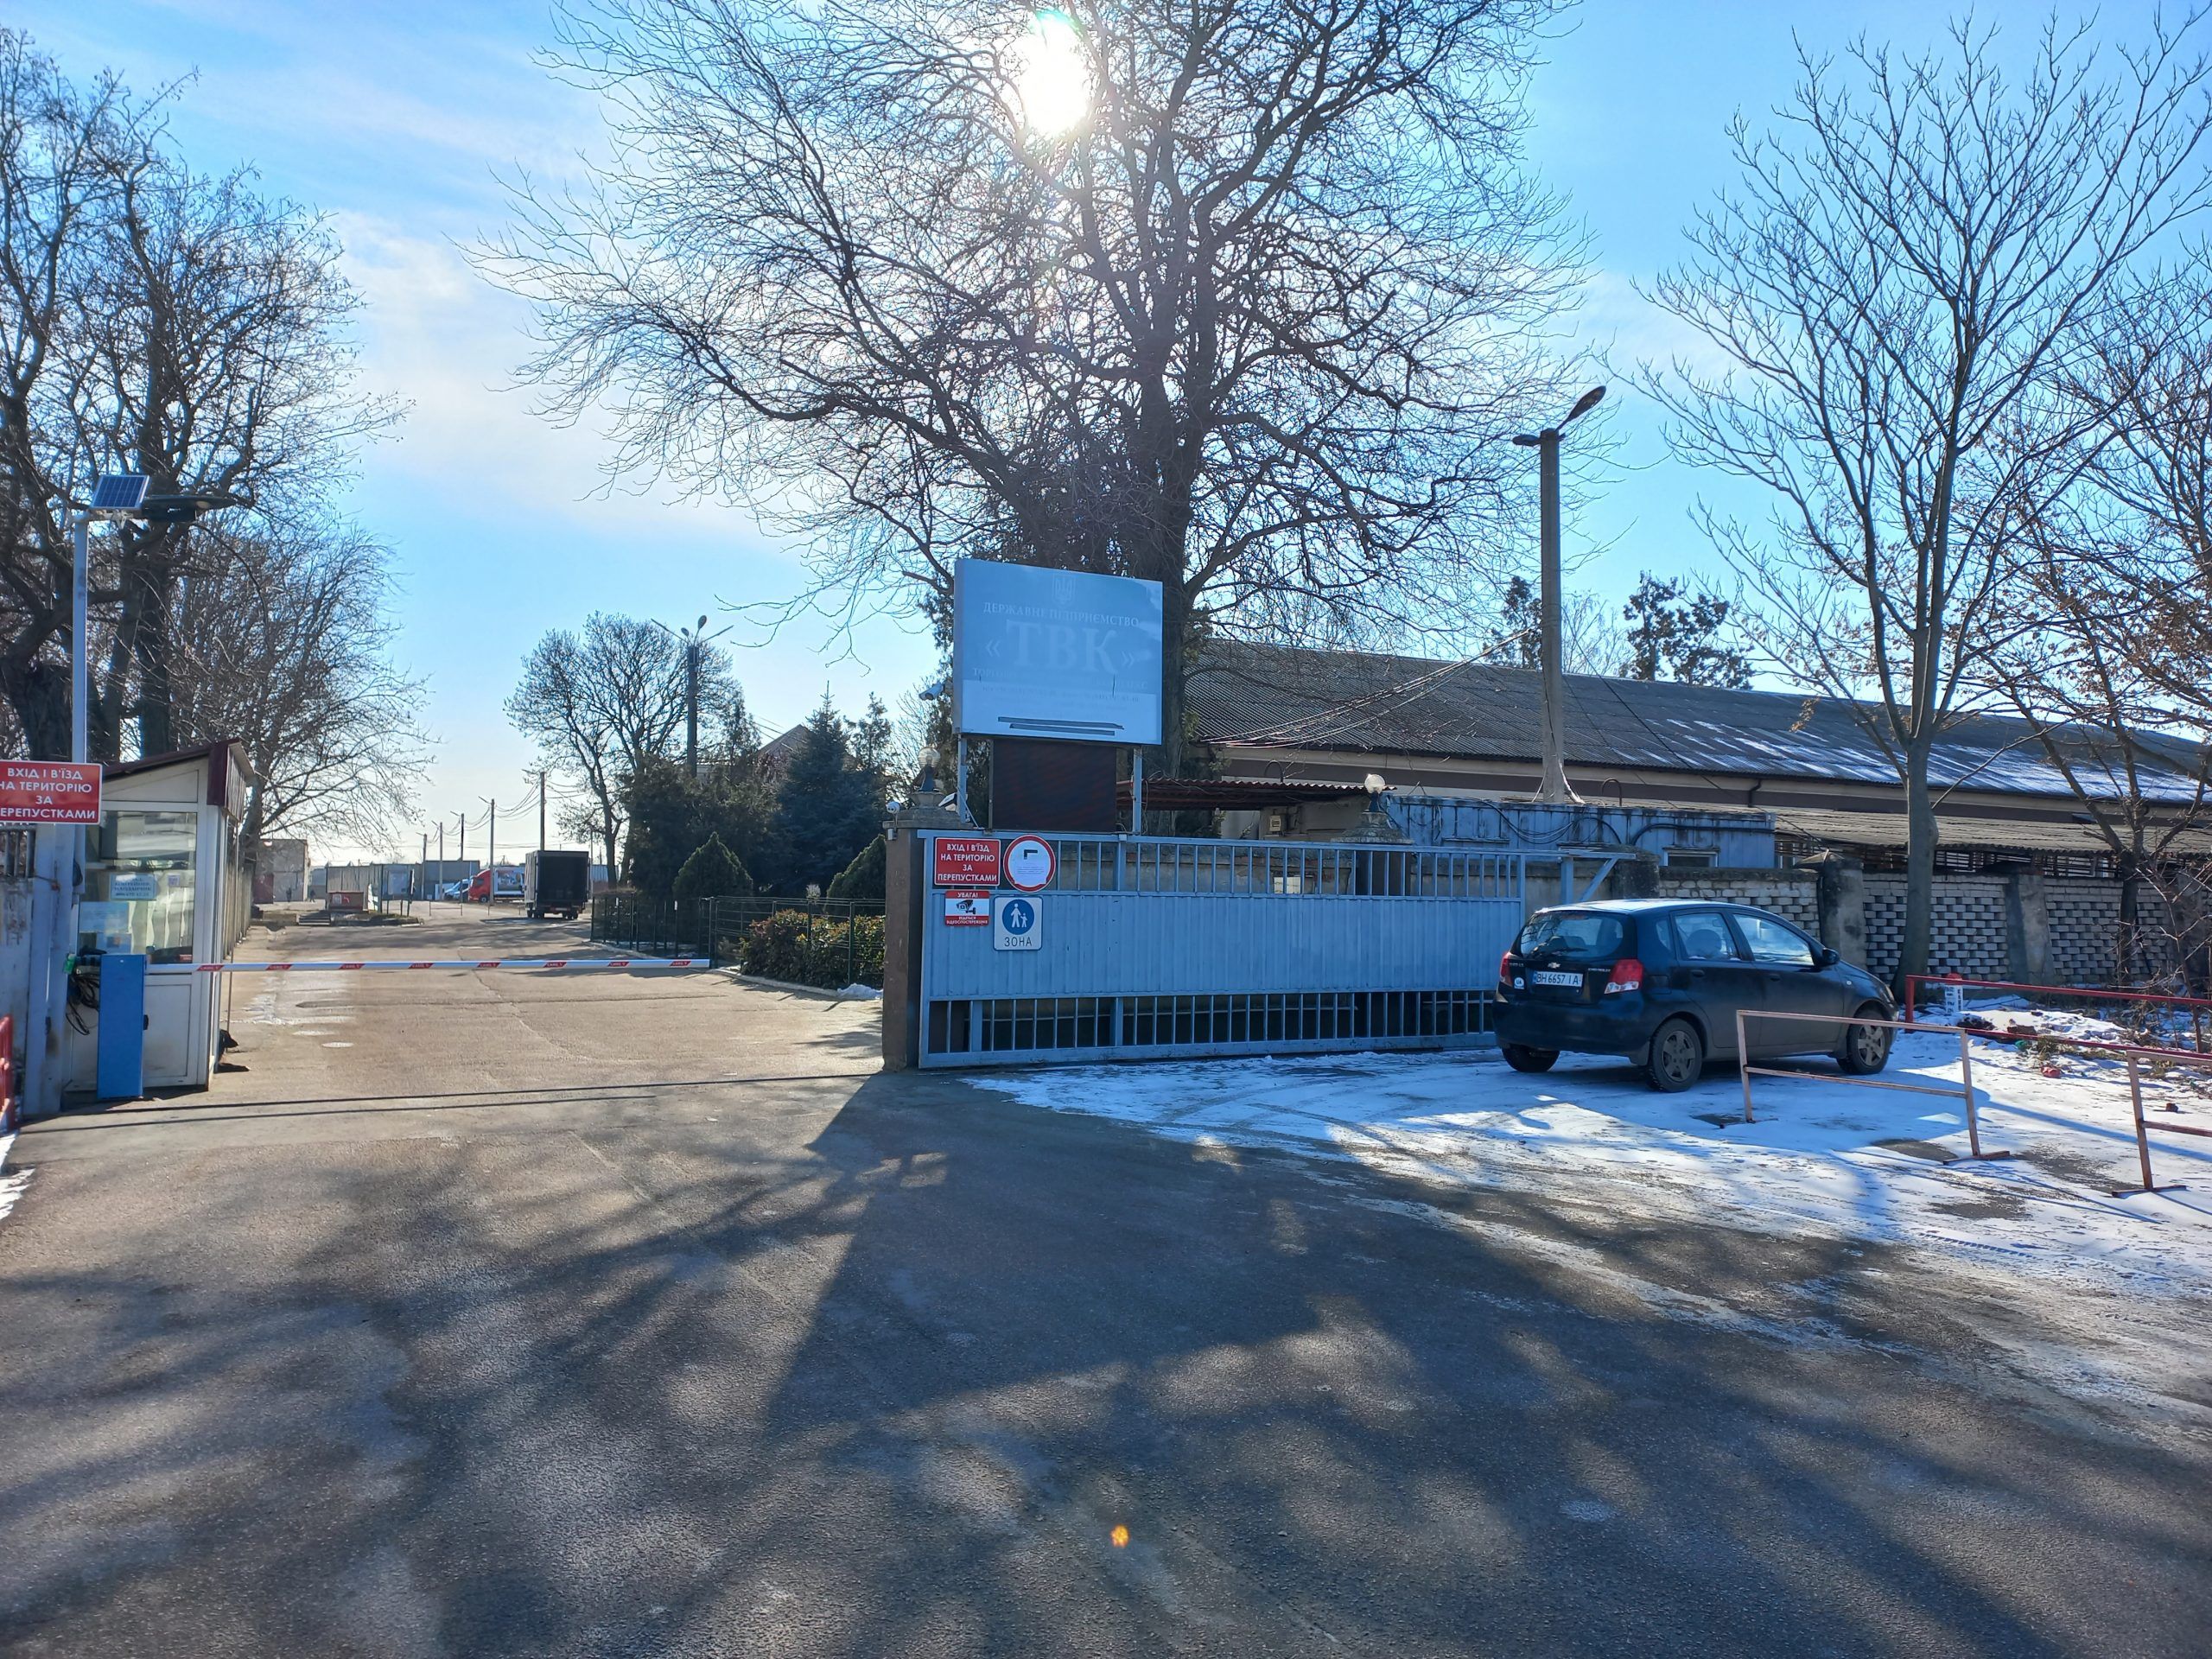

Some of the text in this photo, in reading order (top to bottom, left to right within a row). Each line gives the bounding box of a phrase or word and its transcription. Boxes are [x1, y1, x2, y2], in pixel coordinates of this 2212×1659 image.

[982, 601, 1140, 627] ДЕРЖАВНЕ ПІДПРИЄМСТВО
[7, 768, 83, 780] ВХІД І В'ЇЗД
[19, 781, 92, 793] ТЕРИТОРІЮ
[35, 795, 53, 804] ЗА
[0, 808, 95, 819] ЕРЕПУСТКАМИ
[946, 843, 965, 852] ВХІД
[970, 843, 990, 853] В'ЇЗД
[953, 854, 995, 862] ТЕРИТОРІЮ
[1004, 937, 1033, 947] ЗОНА
[1548, 974, 1566, 984] 6657
